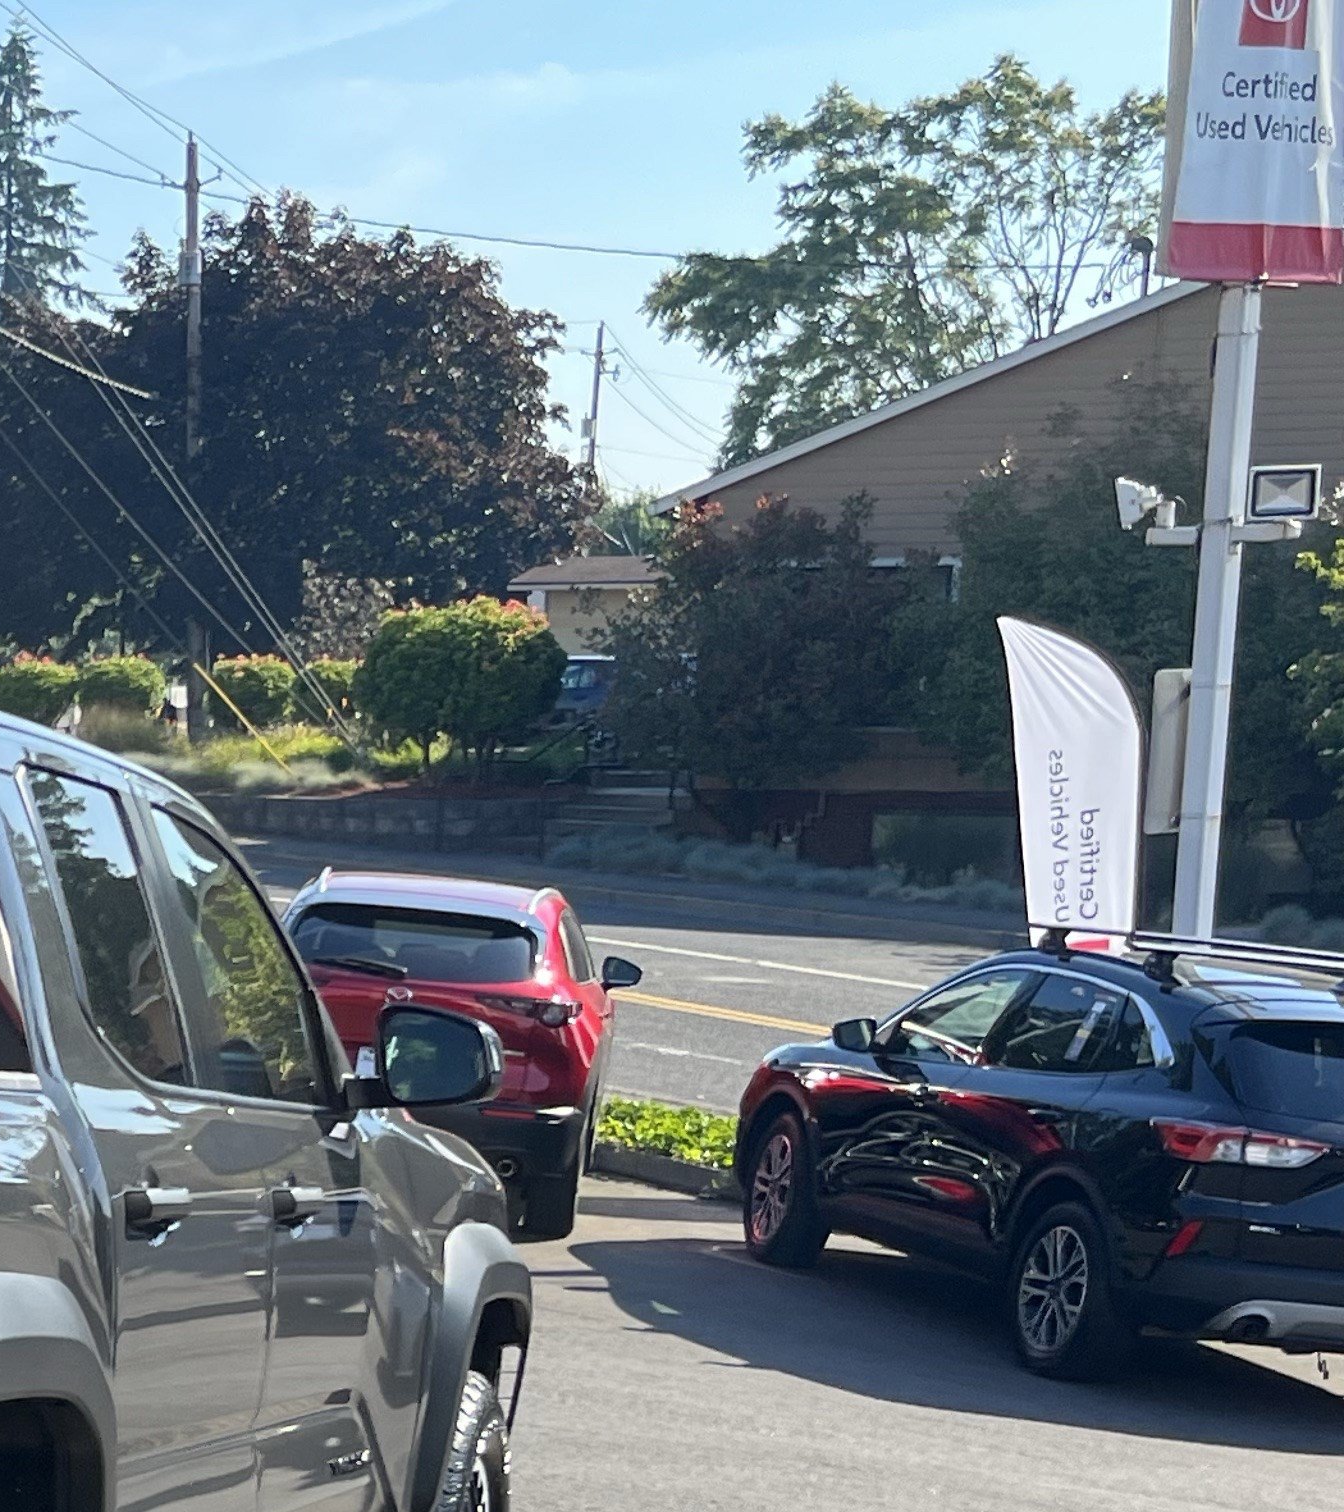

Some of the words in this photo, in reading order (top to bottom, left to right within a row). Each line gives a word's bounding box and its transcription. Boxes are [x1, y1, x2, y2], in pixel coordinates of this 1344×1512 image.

[1221, 70, 1318, 102] Certified
[1196, 111, 1247, 140] Used
[1254, 112, 1334, 147] Vehicles
